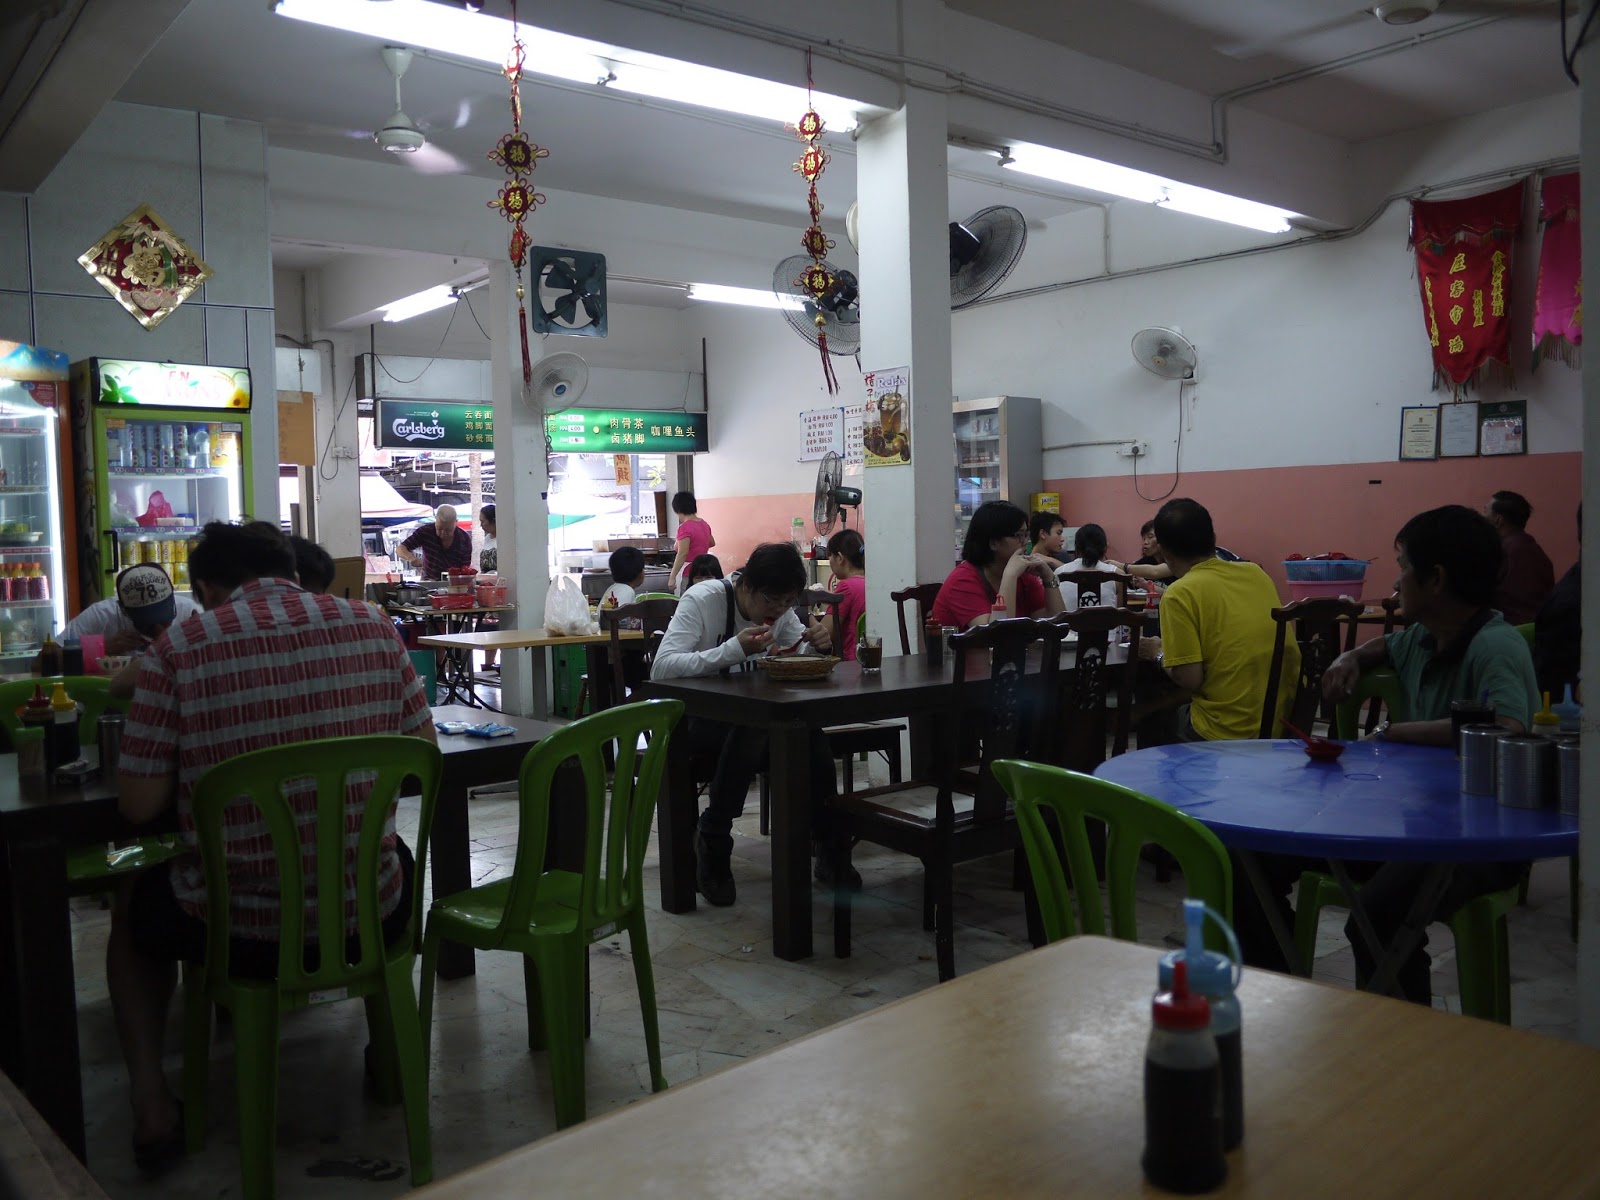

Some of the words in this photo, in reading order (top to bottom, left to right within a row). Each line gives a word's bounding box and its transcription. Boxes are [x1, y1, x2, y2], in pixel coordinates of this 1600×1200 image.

[803, 115, 816, 131] 福
[510, 145, 526, 164] 福
[508, 192, 523, 210] 福
[812, 272, 825, 289] 福
[464, 410, 493, 420] 云吞面
[609, 417, 645, 430] 肉骨茶
[392, 418, 445, 440] Carlsberg
[610, 432, 646, 445] 卤猪脚
[135, 584, 159, 602] 78
